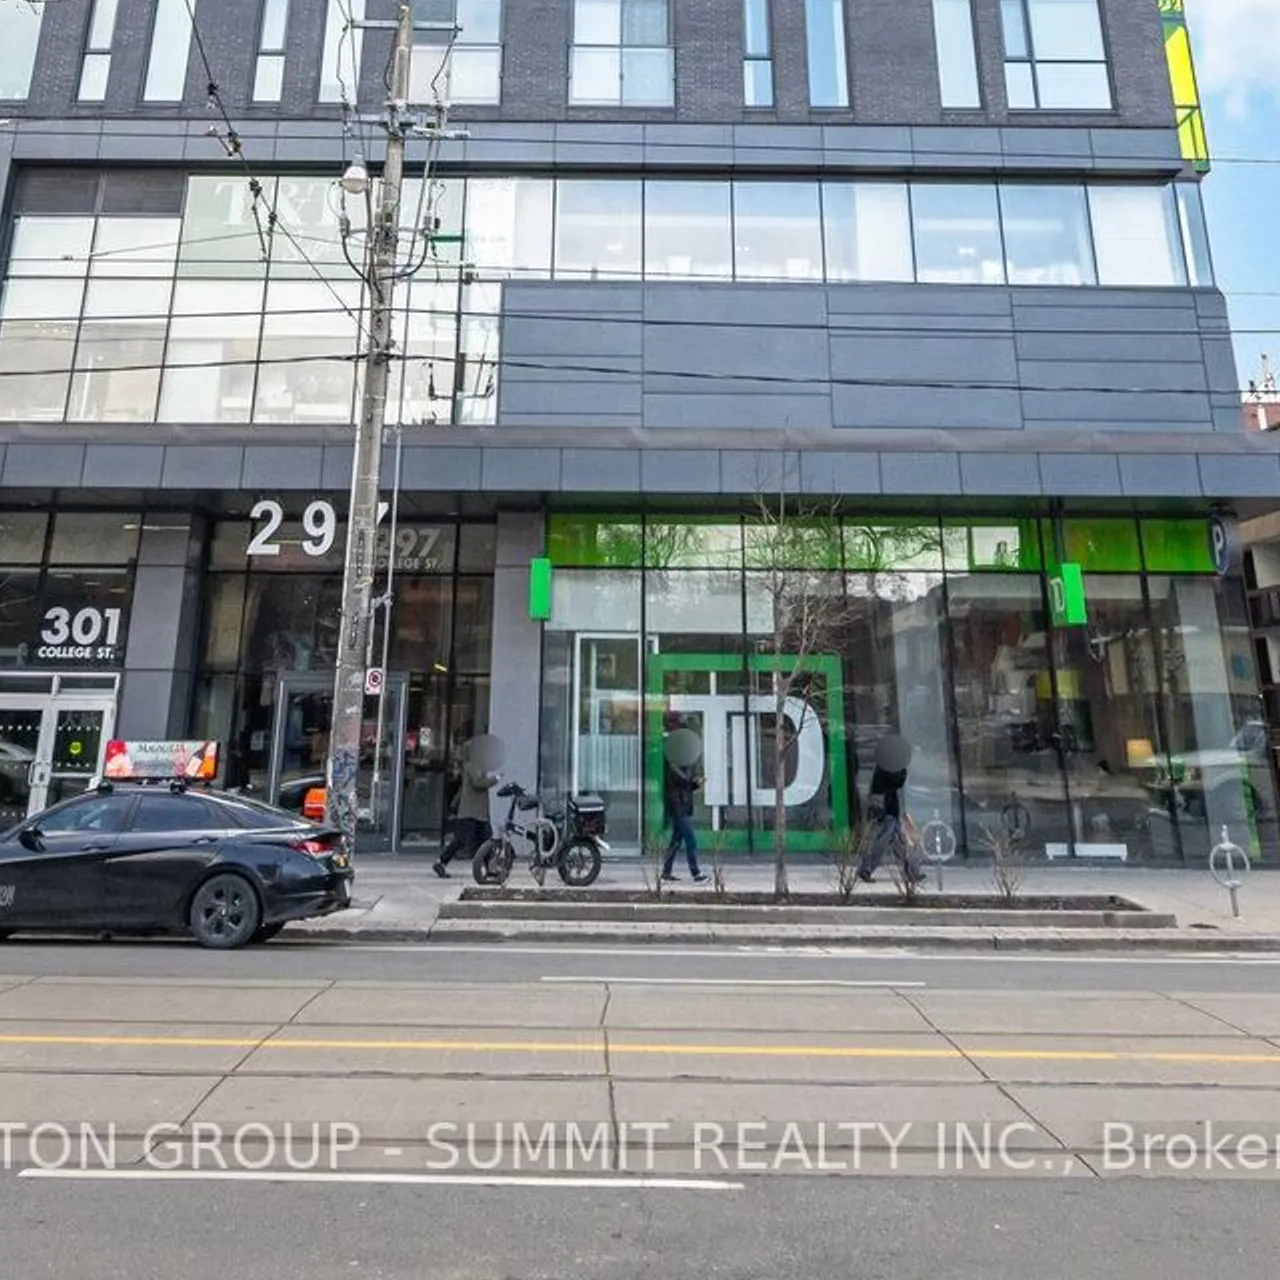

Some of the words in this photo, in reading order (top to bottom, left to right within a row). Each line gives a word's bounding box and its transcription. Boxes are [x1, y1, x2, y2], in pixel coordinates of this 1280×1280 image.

[40, 606, 122, 645] 301
[37, 646, 93, 659] COLLEGE
[96, 646, 116, 659] ST.
[670, 694, 825, 807] TD
